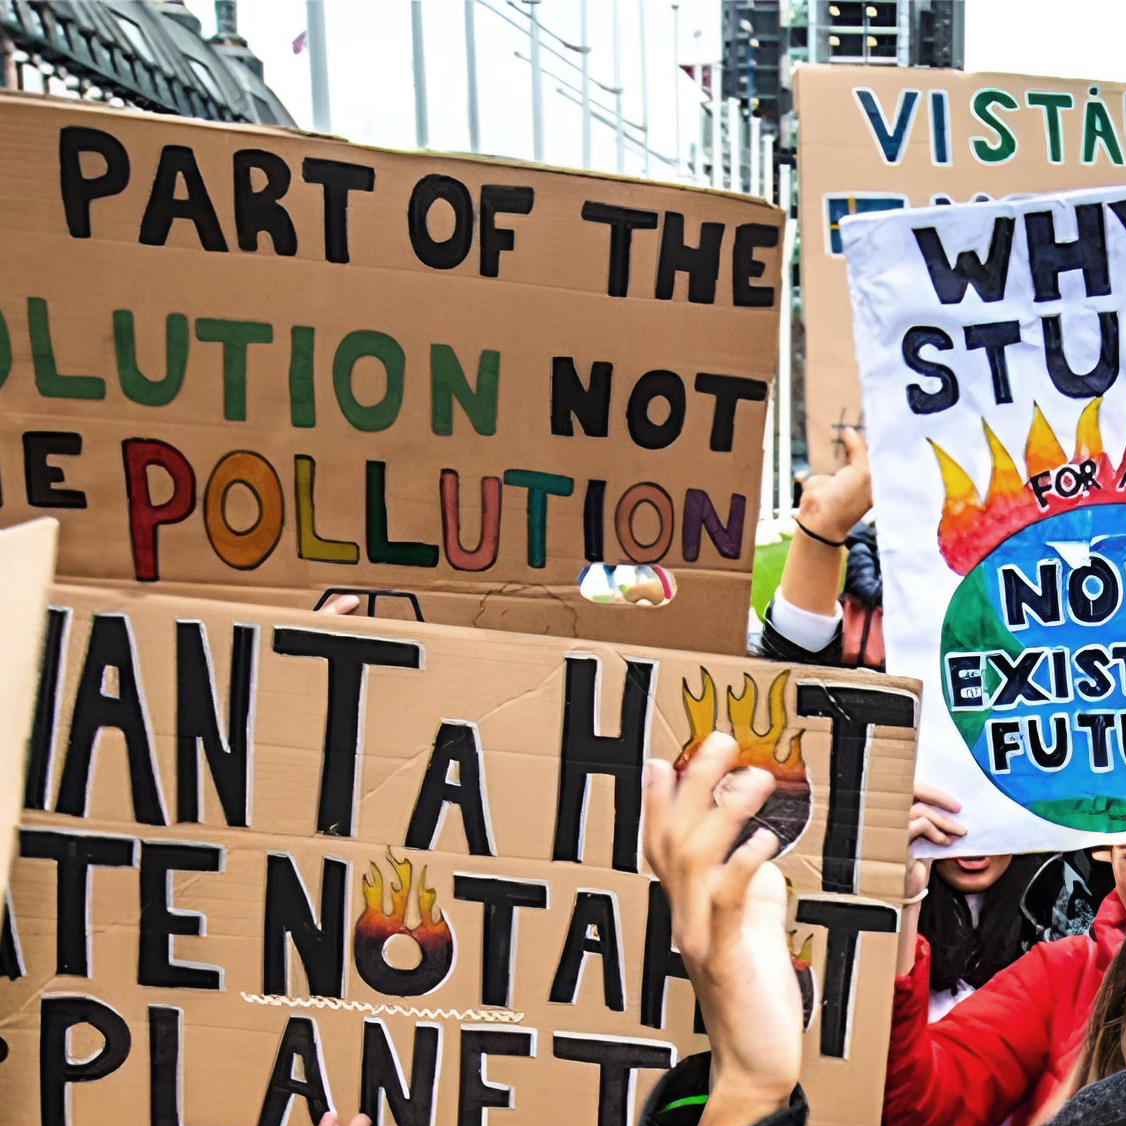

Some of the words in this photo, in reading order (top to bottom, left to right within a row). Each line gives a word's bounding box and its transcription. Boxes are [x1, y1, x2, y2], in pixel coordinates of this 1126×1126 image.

[853, 87, 954, 167] VI
[59, 126, 376, 264] PART
[408, 174, 534, 278] OF
[581, 200, 780, 307] THE
[0, 297, 500, 436] LUTION
[550, 356, 768, 452] NOT
[121, 437, 746, 582] POLLUTION
[1028, 458, 1102, 508] FOR
[24, 604, 427, 838] ANT
[404, 716, 497, 858] A
[640, 879, 900, 1060] HT
